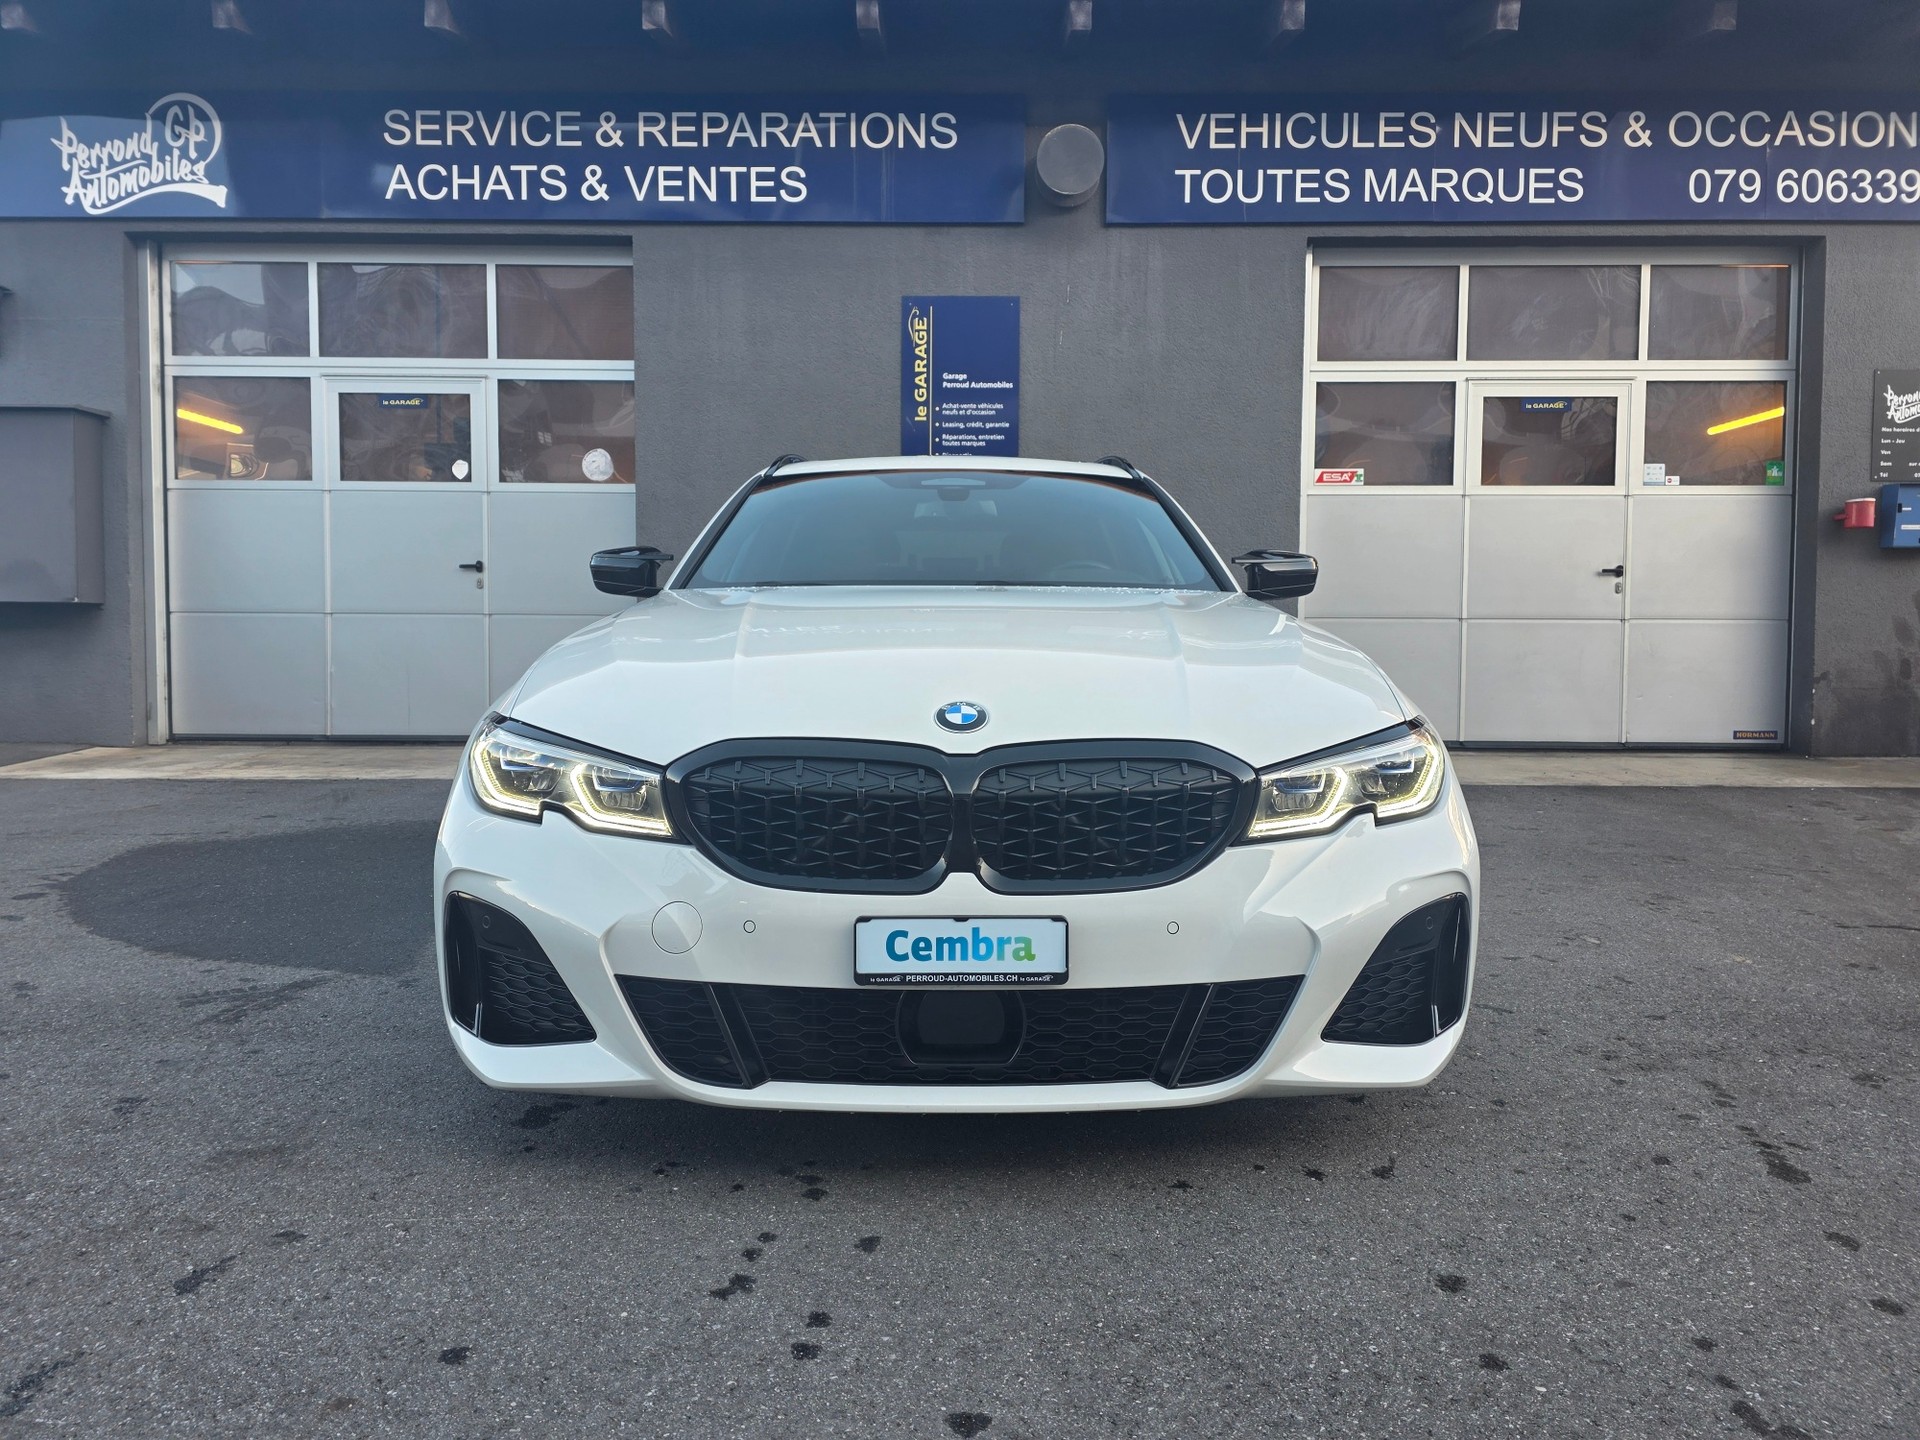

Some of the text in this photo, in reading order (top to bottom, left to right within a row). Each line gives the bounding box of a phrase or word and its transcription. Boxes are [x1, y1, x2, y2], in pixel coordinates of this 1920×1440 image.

[383, 110, 958, 149] SERVICE & REPARATIONS
[1176, 111, 1918, 149] VEHICULES NEUFS & OCCASION
[385, 164, 808, 203] ACHATS & VENTES
[1174, 168, 1585, 205] TOUTES MARQUES
[1688, 168, 1920, 204] 079 606339
[914, 317, 927, 421] le GARAGE
[942, 372, 967, 380] Garage
[942, 381, 1014, 389] Perroud Automobiles
[885, 927, 1036, 962] Cembra
